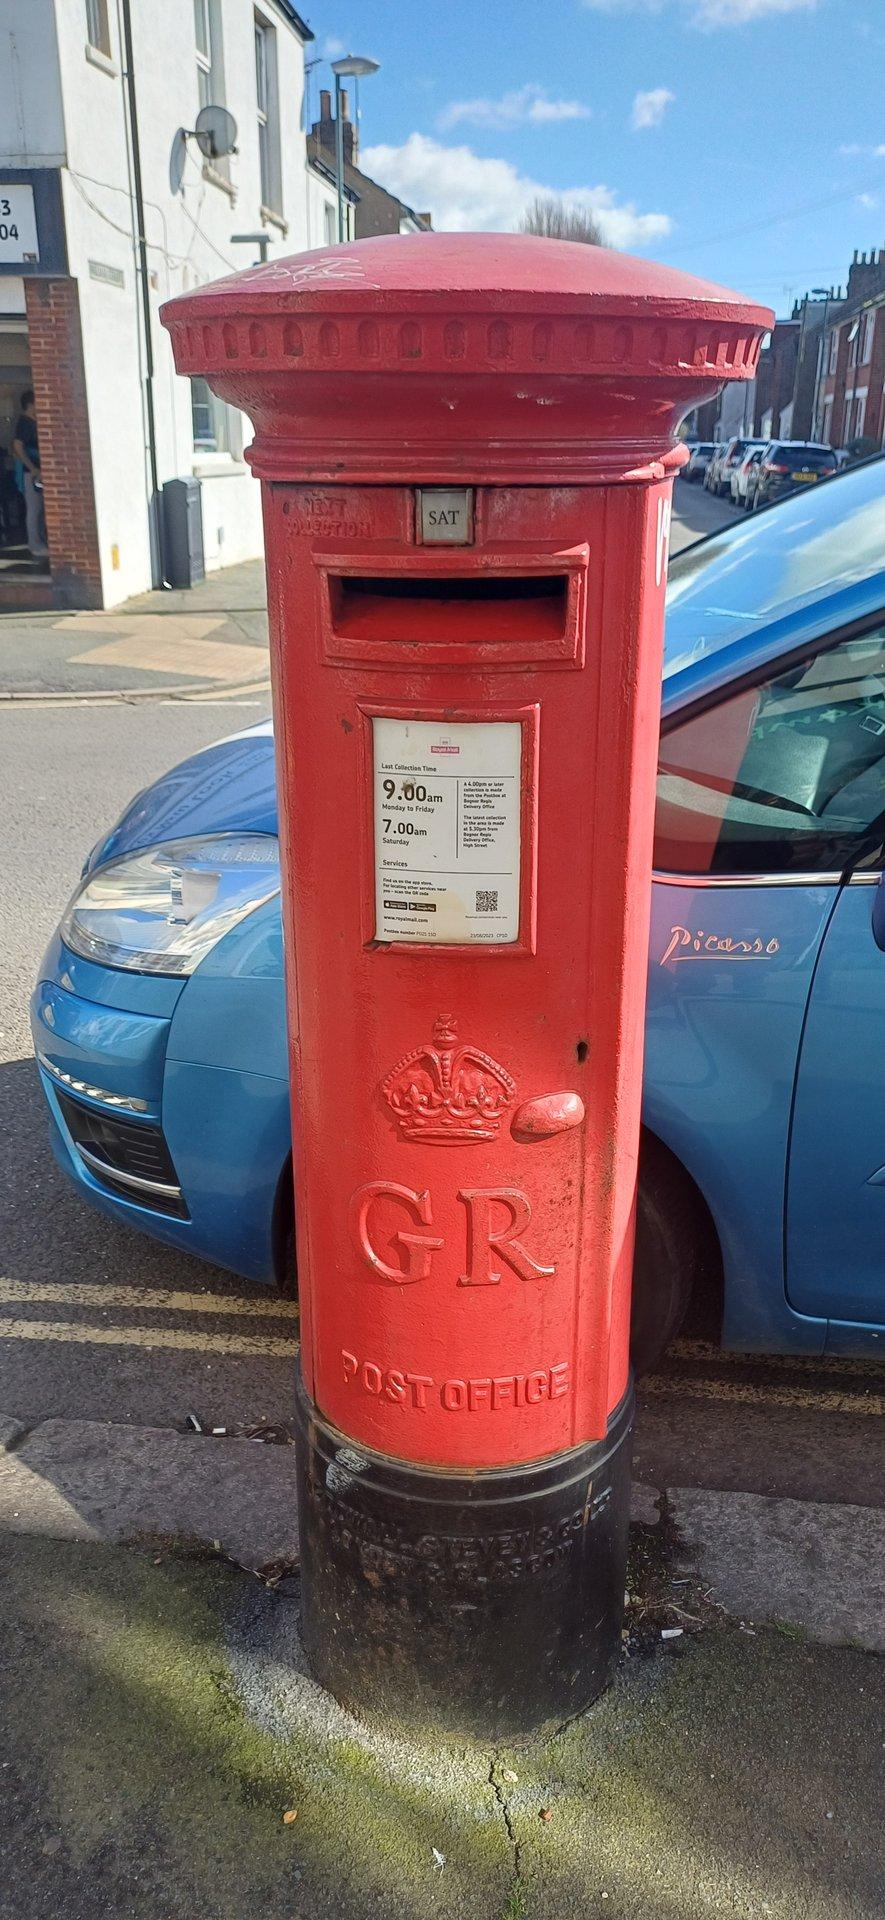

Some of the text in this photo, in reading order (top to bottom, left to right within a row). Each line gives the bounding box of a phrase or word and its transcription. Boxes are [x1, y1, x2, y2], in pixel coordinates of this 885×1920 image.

[0, 199, 11, 216] 3
[0, 224, 19, 241] 04
[428, 510, 460, 526] SAT
[394, 764, 422, 772] Collection
[382, 804, 406, 812] Monday
[382, 819, 427, 836] 7.00am
[382, 838, 410, 846] Saturday
[382, 860, 408, 868] Services
[660, 925, 779, 966] Picasso
[351, 1180, 557, 1288] GR
[341, 1349, 570, 1412] POST OFFICE
